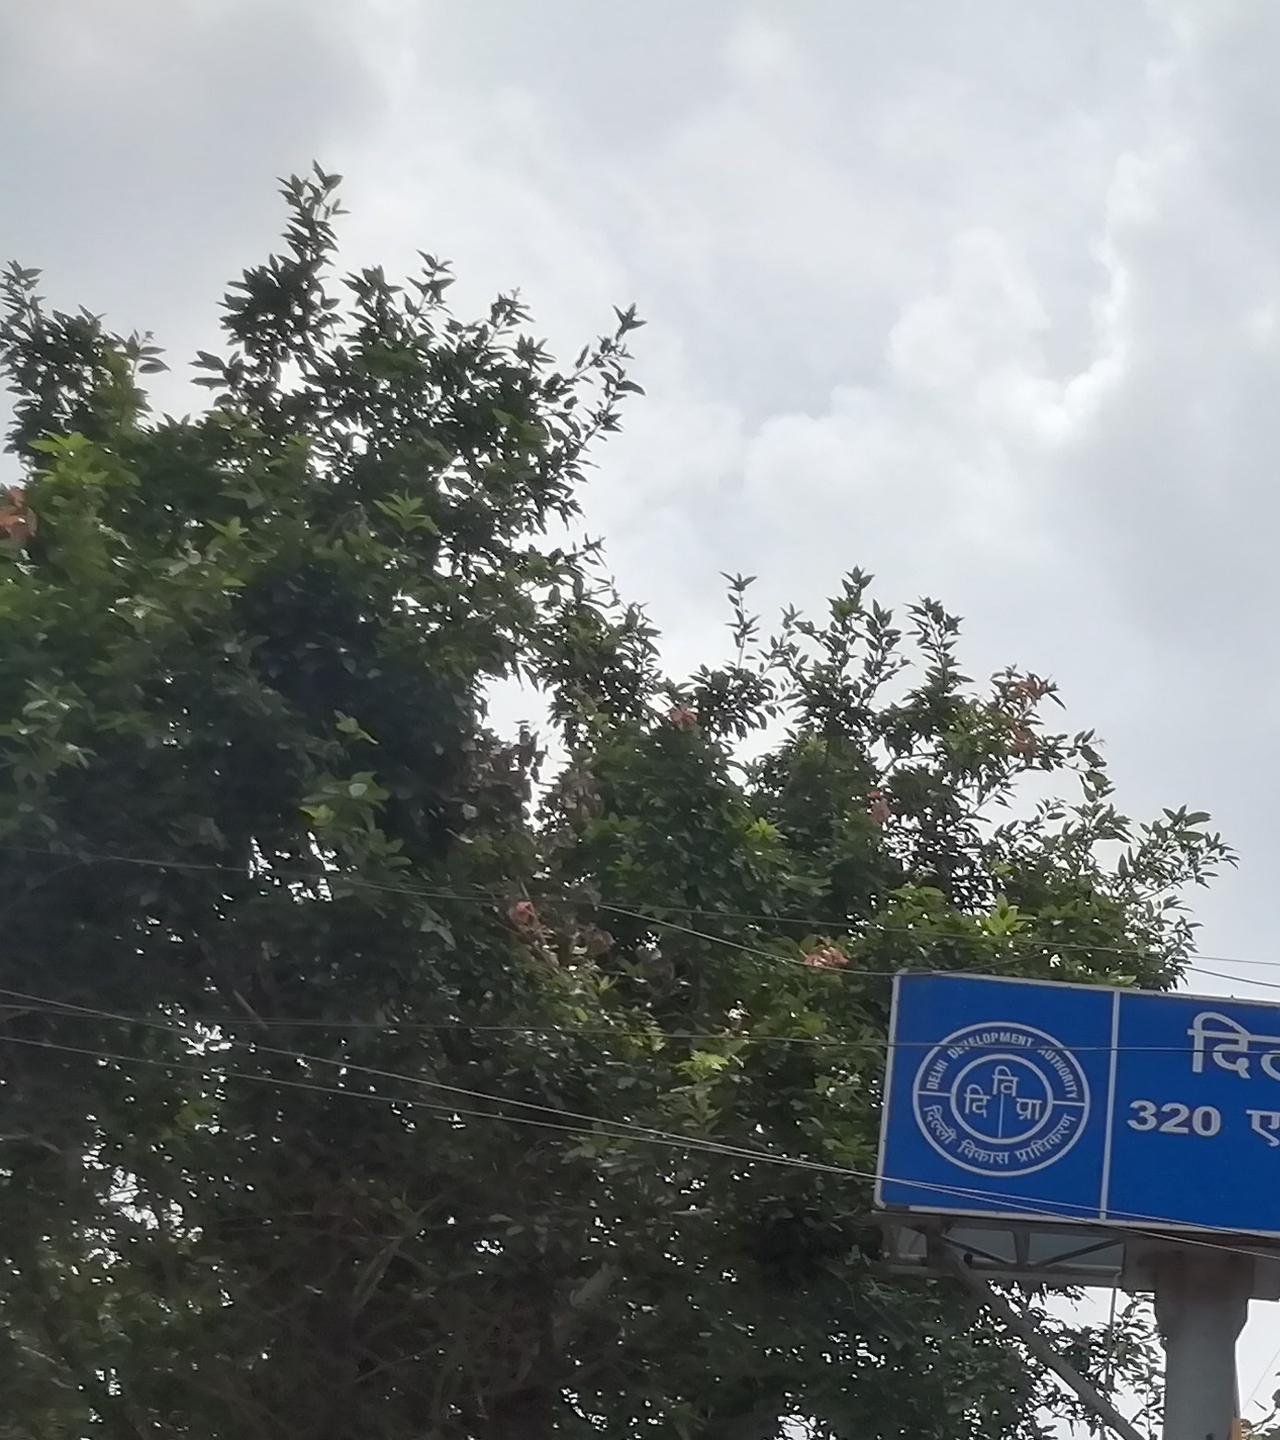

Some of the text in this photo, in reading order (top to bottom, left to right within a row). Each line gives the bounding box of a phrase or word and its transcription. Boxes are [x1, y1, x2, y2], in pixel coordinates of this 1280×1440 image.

[926, 1031, 1079, 1099] DELHI DEVELOPMENT AUTHORITY
[992, 1064, 1019, 1097] वि
[963, 1083, 991, 1118] दि
[1126, 1099, 1222, 1137] 320
[922, 1104, 958, 1144] दिल्ली
[956, 1138, 1010, 1165] विकास
